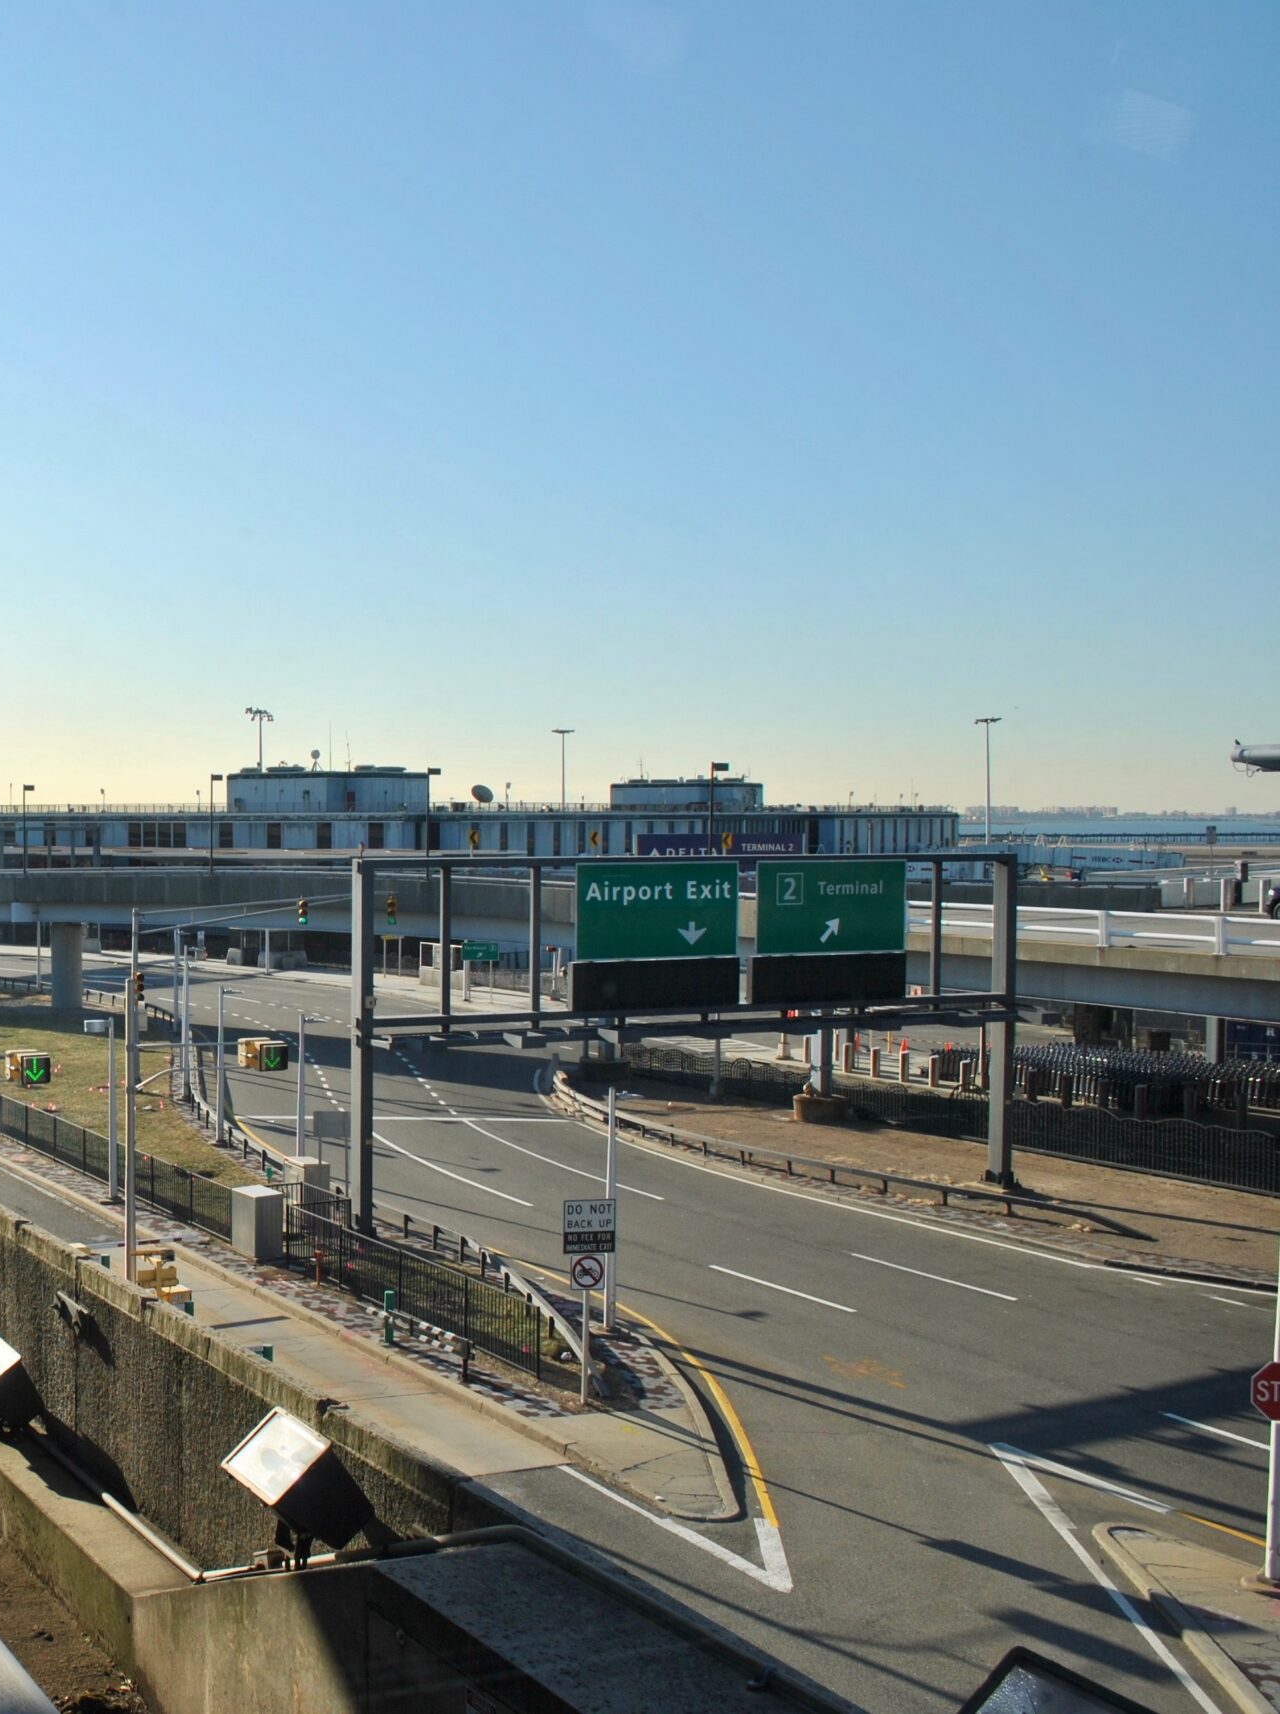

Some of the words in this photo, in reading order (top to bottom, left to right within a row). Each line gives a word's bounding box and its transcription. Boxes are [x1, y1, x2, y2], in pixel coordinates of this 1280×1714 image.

[741, 843, 786, 852] TERMINAL
[788, 843, 794, 852] 2
[586, 880, 673, 906] Airport
[686, 879, 732, 900] Exit
[783, 878, 797, 900] 2
[818, 880, 884, 896] Terminal
[567, 1204, 583, 1215] DO
[590, 1203, 612, 1214] NOT
[567, 1219, 593, 1229] BACK
[599, 1218, 612, 1228] UP
[567, 1234, 578, 1242] NO
[581, 1233, 594, 1241] FEE
[597, 1233, 611, 1241] FOR
[566, 1244, 597, 1252] IMMEDIATE
[599, 1243, 612, 1251] EXIT
